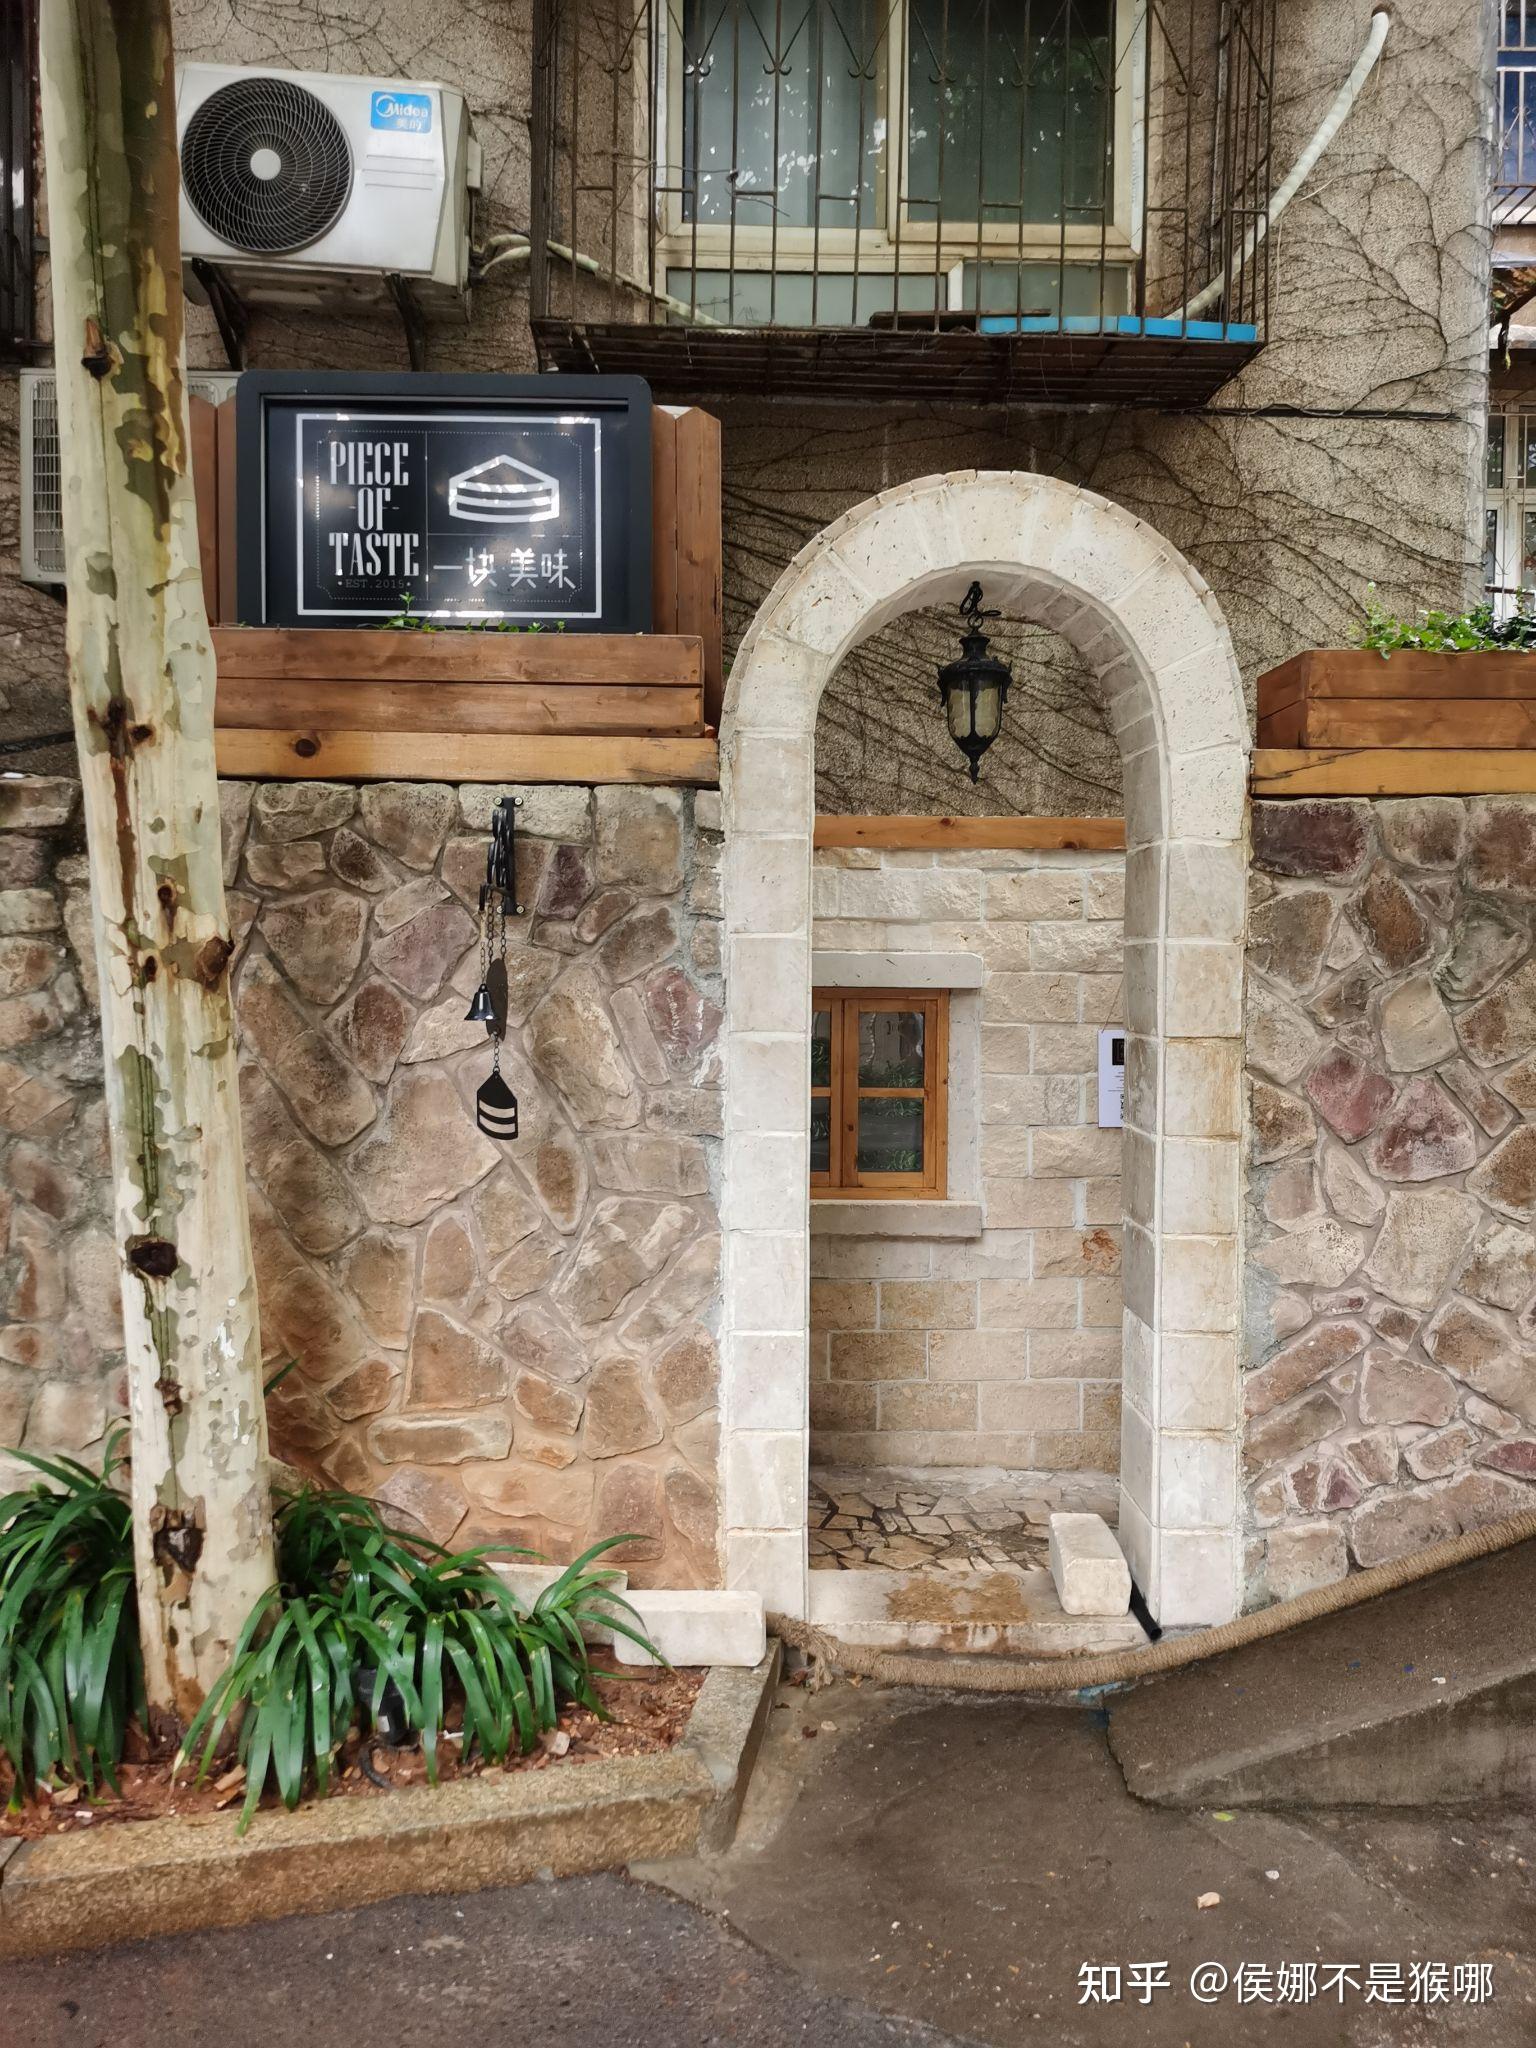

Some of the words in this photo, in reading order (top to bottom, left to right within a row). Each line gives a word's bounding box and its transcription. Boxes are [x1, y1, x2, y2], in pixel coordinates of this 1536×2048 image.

[376, 95, 429, 118] Midea
[330, 441, 409, 486] PIECE
[357, 487, 391, 531] OF
[329, 532, 419, 577] TASTE
